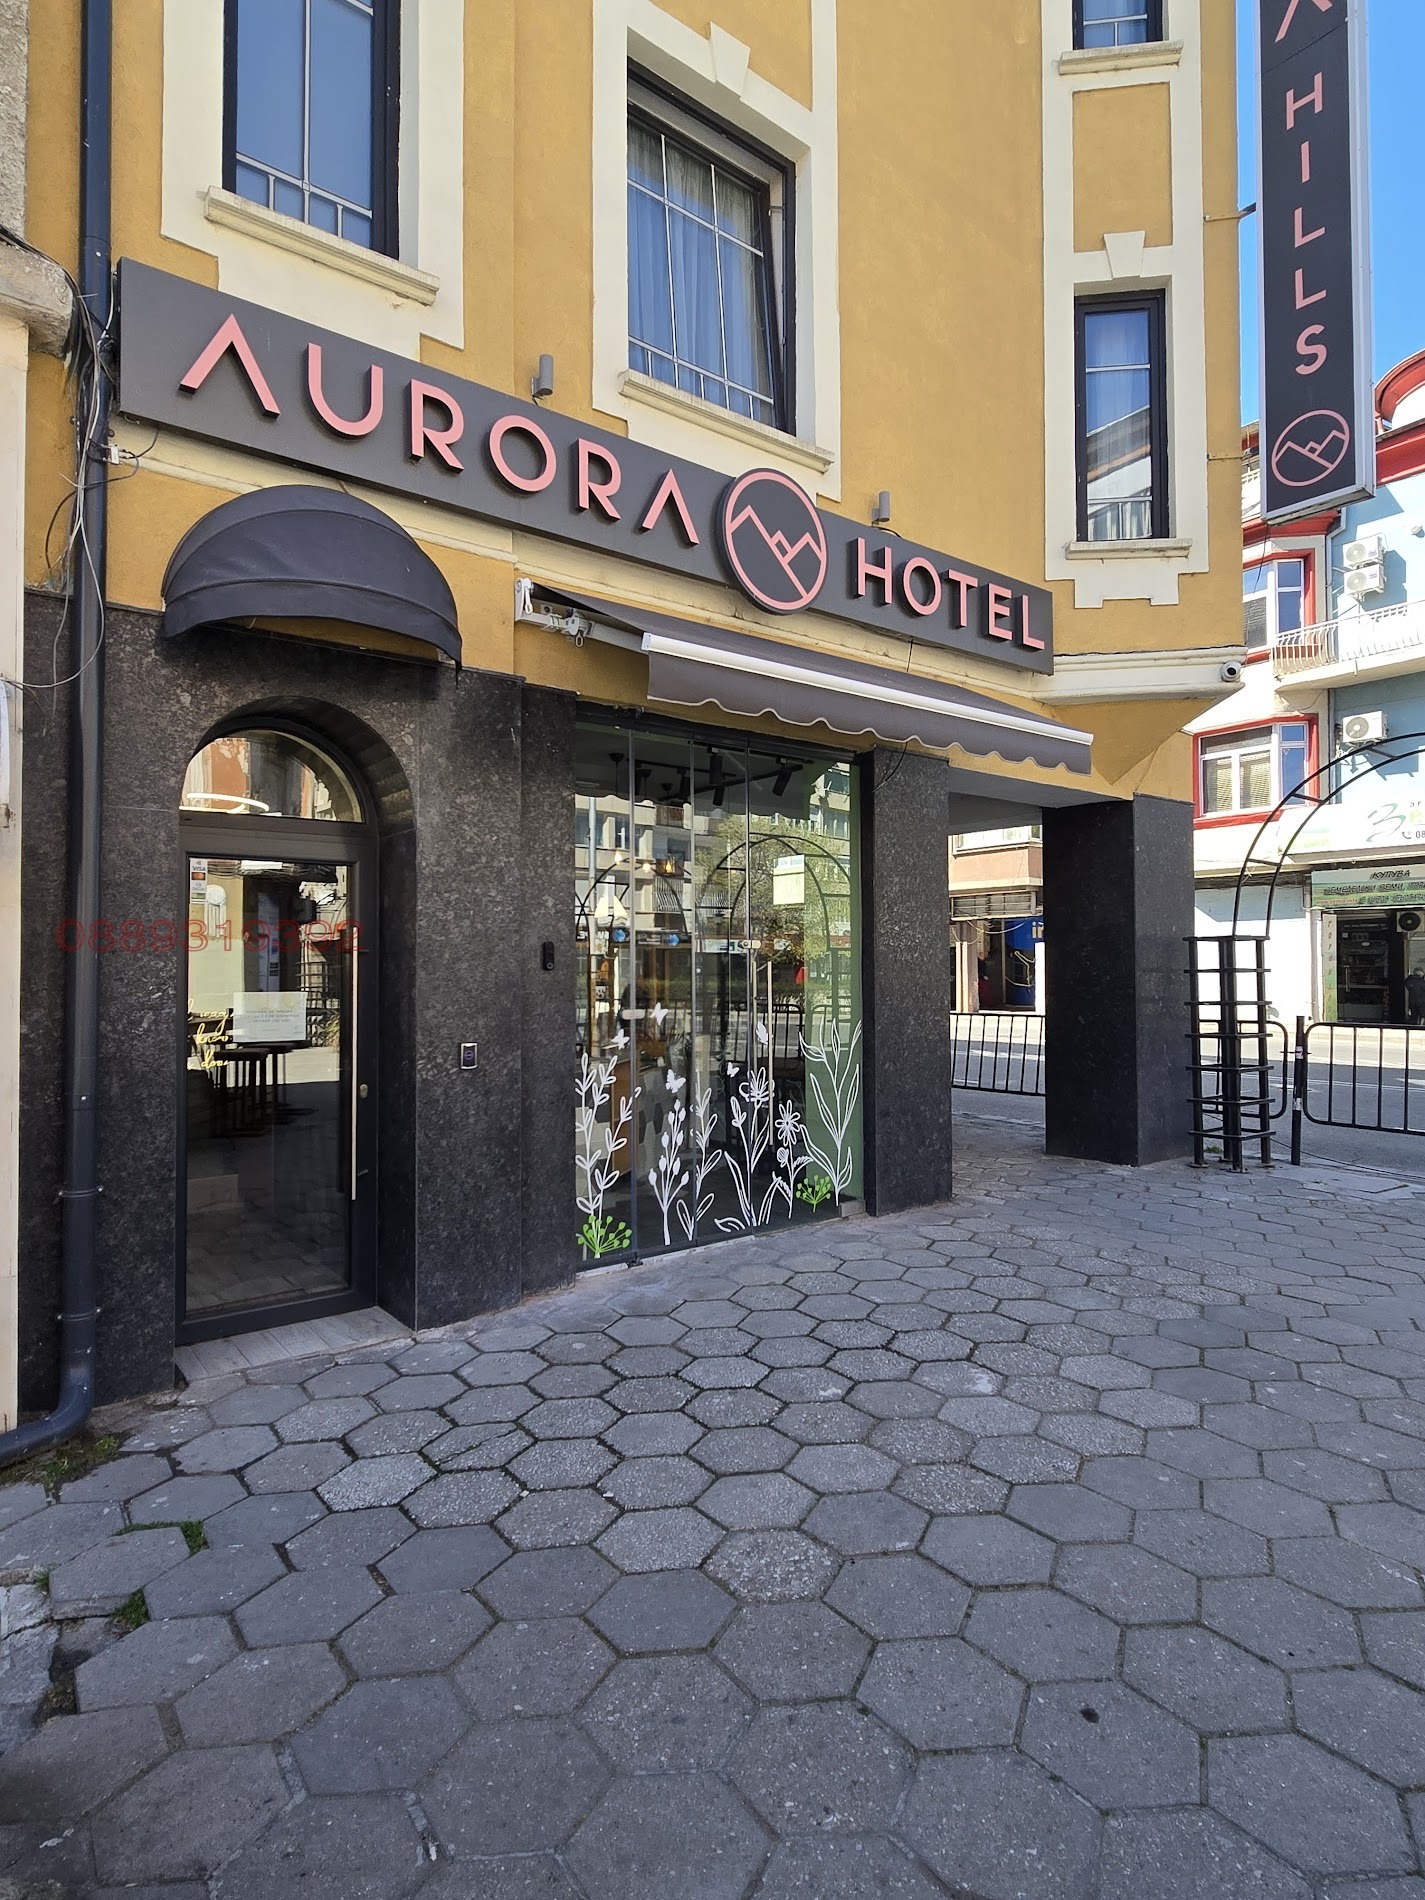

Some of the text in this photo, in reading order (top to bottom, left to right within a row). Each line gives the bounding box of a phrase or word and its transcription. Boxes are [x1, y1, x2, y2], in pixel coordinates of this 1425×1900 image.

[1285, 71, 1328, 376] HILLS
[178, 313, 1046, 651] AURORA HOTEL
